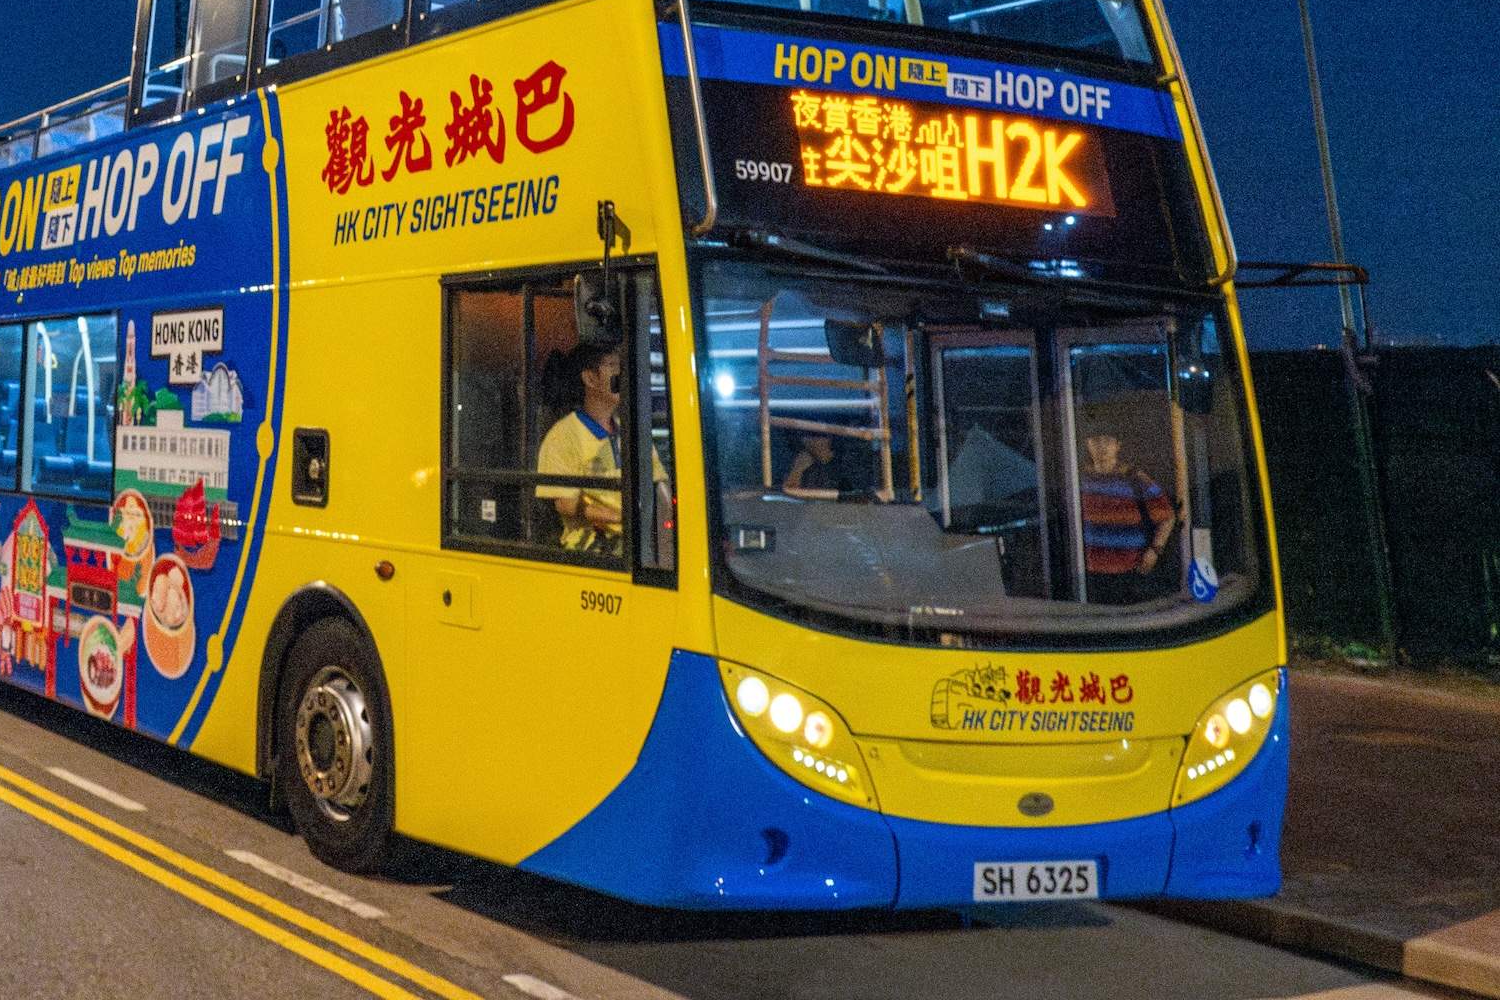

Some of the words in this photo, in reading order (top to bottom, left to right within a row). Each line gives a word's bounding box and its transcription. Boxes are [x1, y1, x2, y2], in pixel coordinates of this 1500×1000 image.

[773, 43, 846, 84] HOP
[850, 52, 897, 91] ON
[790, 90, 913, 142] 夜賞香港
[995, 71, 1055, 110] HOP
[1059, 80, 1112, 120] OFF
[321, 60, 575, 196] 觀光城巴
[77, 143, 160, 242] HOP
[161, 114, 251, 226] OFF
[735, 159, 793, 184] 59907
[964, 115, 1088, 207] H2K
[333, 209, 361, 247] HK
[362, 201, 408, 241] CITY
[409, 174, 560, 234] SIGHTSEEING
[68, 258, 86, 288] Top
[86, 254, 116, 281] views
[118, 249, 136, 282] Top
[137, 240, 197, 274] memories
[155, 321, 185, 345] HONG
[188, 317, 219, 343] KONG
[580, 590, 623, 616] 59907
[1014, 668, 1134, 705] 觀光城巴
[961, 710, 987, 731] HK
[989, 710, 1030, 731] CITY
[1030, 710, 1135, 732] SIGHTSEEING
[983, 867, 1015, 895] SH
[1026, 866, 1090, 895] 6325
